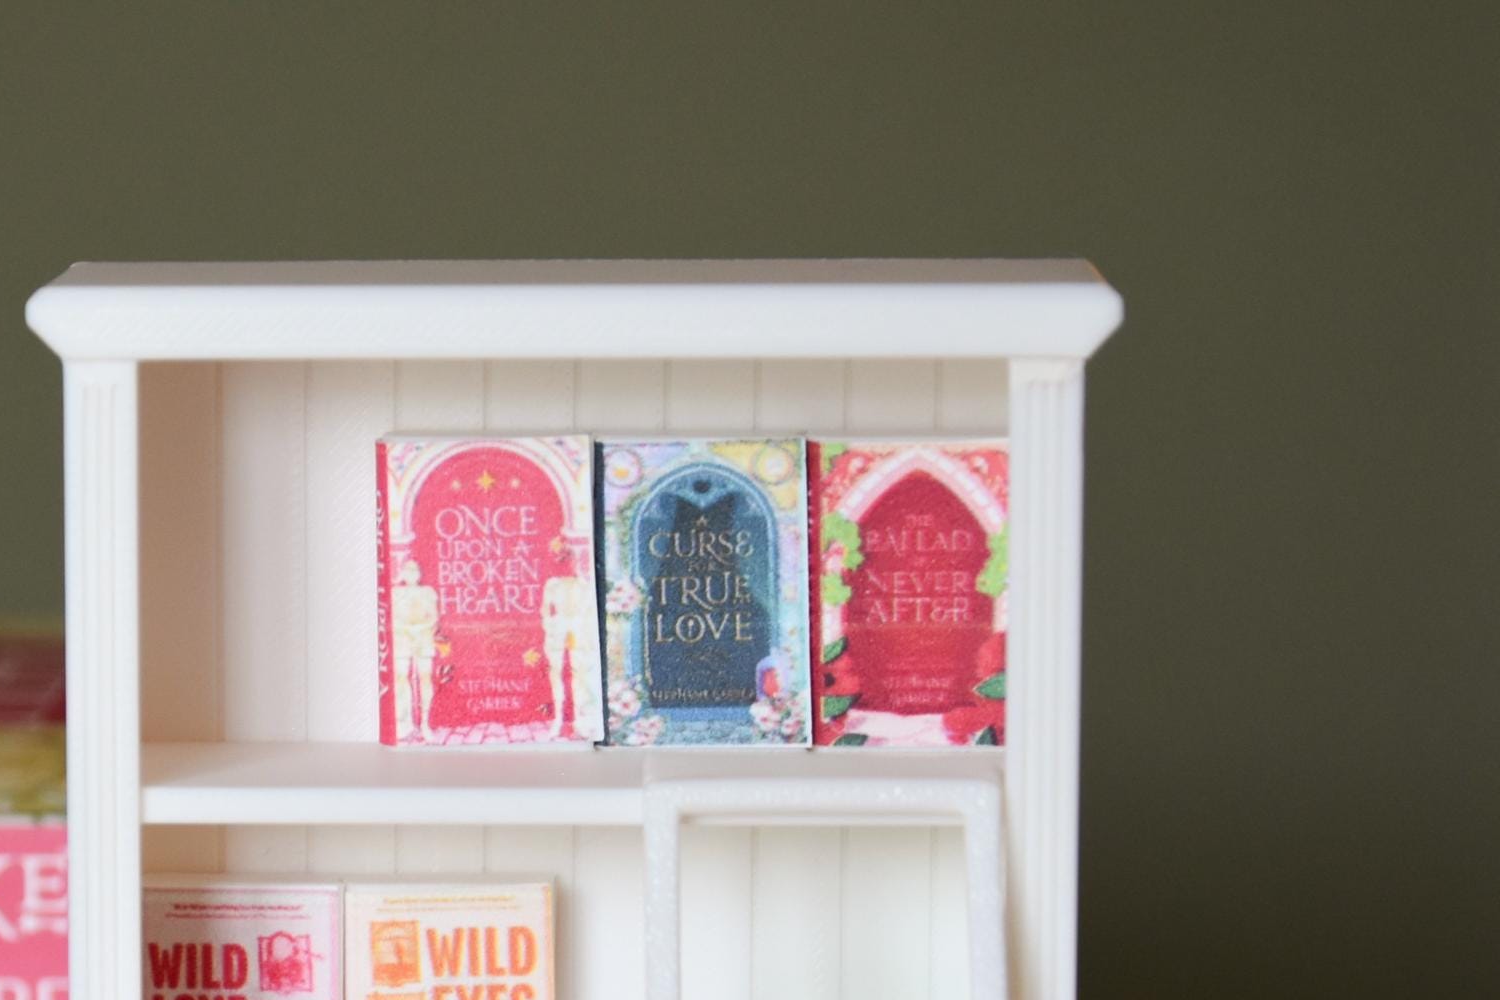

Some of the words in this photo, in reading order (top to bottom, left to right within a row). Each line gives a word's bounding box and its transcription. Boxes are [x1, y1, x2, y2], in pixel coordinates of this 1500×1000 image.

[435, 505, 538, 538] ONCE
[437, 537, 505, 559] UPON
[511, 541, 533, 557] A
[648, 529, 754, 564] CURSE
[438, 557, 540, 584] BROKEN
[865, 569, 970, 594] NEVER
[440, 584, 540, 614] HEART
[651, 572, 752, 610] TRUE
[866, 597, 970, 622] AFTER
[655, 612, 753, 642] LOVE
[148, 942, 248, 990] WILD
[426, 926, 537, 977] WILD
